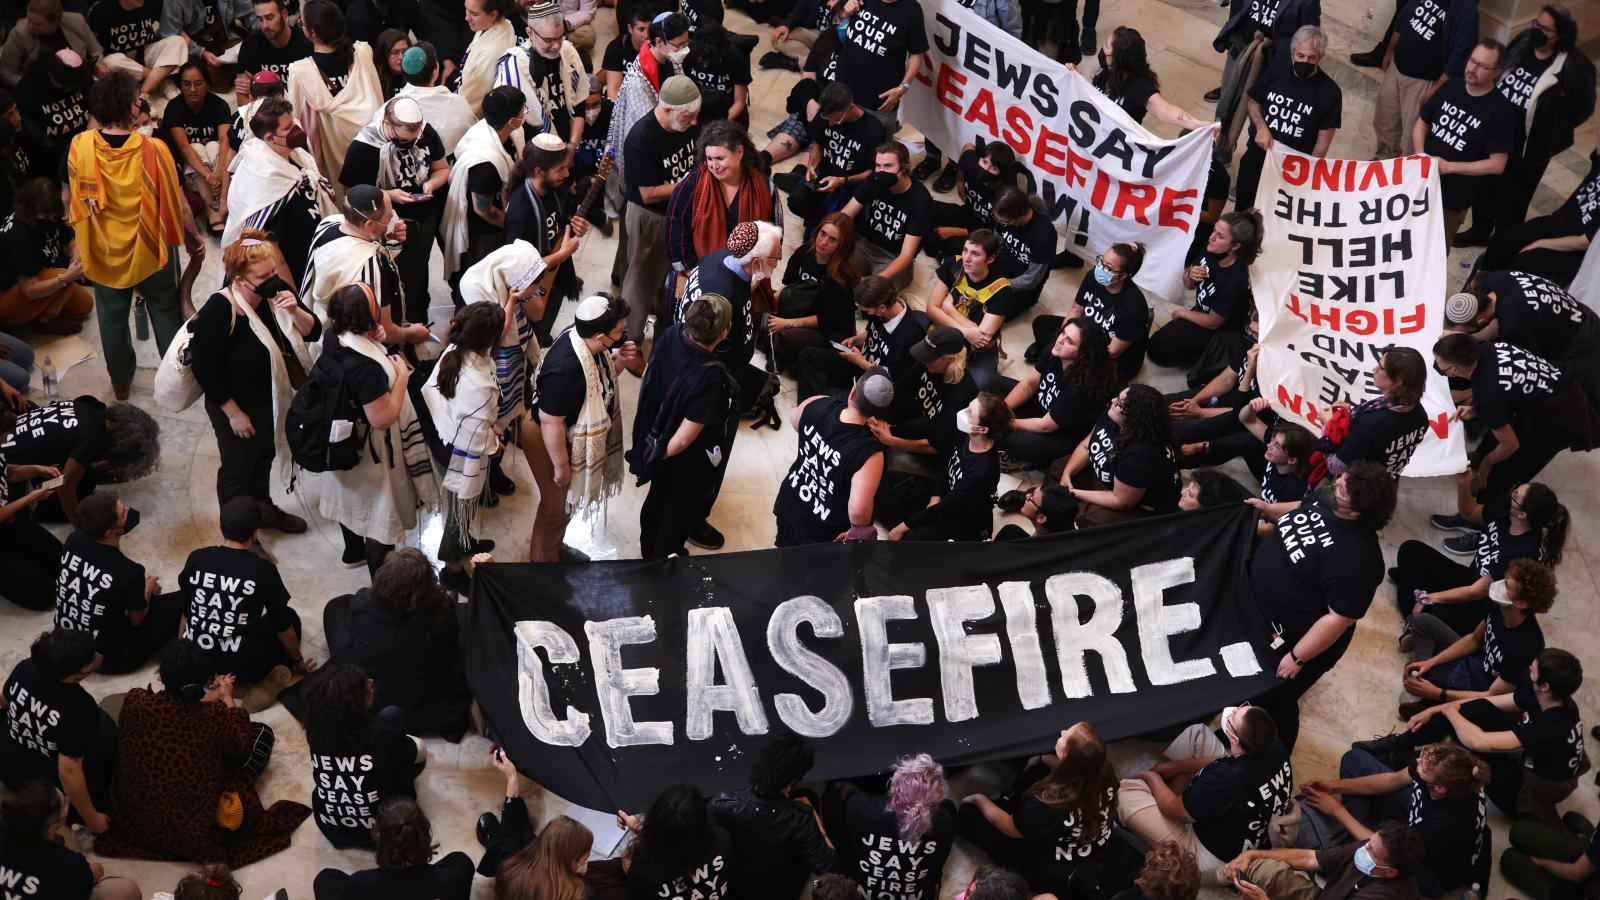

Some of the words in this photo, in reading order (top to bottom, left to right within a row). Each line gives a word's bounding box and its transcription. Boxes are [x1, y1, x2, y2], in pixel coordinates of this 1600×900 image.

[1424, 0, 1440, 13] OT
[110, 24, 136, 35] NOT
[141, 18, 152, 28] IN
[854, 20, 885, 43] OUR
[858, 10, 880, 24] NOT
[882, 22, 897, 35] IN
[118, 31, 148, 44] OUR
[847, 27, 887, 56] NAME
[261, 64, 288, 73] NOT
[1516, 67, 1531, 80] OT
[934, 12, 1059, 117] JEWS
[1068, 100, 1176, 178] SAY
[1505, 74, 1534, 96] OUR
[42, 99, 66, 114] NOT
[71, 92, 84, 104] IN
[52, 104, 84, 124] OUR
[1267, 92, 1294, 108] NOT
[1297, 102, 1313, 116] IN
[1268, 104, 1302, 125] OUR
[1442, 100, 1466, 119] NOT
[1466, 115, 1482, 130] IN
[184, 126, 198, 136] OT
[1431, 122, 1467, 152] NAME
[1440, 114, 1467, 136] OUR
[824, 128, 845, 144] NOT
[848, 139, 862, 151] IN
[830, 140, 850, 159] OUR
[662, 148, 684, 168] NOT
[672, 155, 694, 178] OUR
[1281, 154, 1431, 192] LIVING
[872, 198, 894, 213] NOT
[897, 210, 908, 224] IN
[1274, 188, 1347, 228] THE
[1359, 187, 1429, 225] FOR
[874, 210, 901, 230] OUR
[1287, 229, 1412, 267] HELL
[1297, 270, 1405, 302] LIKE
[1510, 270, 1540, 310] JEWS
[1084, 306, 1110, 330] OUR
[1285, 293, 1425, 335] FIGHT
[1494, 342, 1512, 392] JEWS
[1512, 345, 1526, 384] SAY
[59, 400, 80, 430] EWS
[918, 387, 936, 419] OUR
[804, 425, 840, 467] JEWS
[1097, 428, 1114, 452] NOT
[1386, 426, 1425, 454] JEWS
[1278, 512, 1306, 564] NAME
[1293, 513, 1316, 548] OUR
[1309, 504, 1325, 529] OT
[1318, 531, 1334, 548] IN
[1488, 522, 1499, 546] NOT
[61, 550, 113, 589] JEWS
[60, 568, 100, 600] SAY
[189, 570, 256, 596] JEWS
[56, 579, 106, 616] EASE
[195, 588, 242, 611] SAY
[190, 600, 248, 625] CEASE
[182, 623, 242, 652] NOW
[190, 614, 236, 638] FIRE
[514, 556, 1263, 748] CEASEFIRE.
[1492, 646, 1503, 663] IN
[10, 682, 60, 727] JEWS
[10, 700, 48, 736] SAY
[312, 754, 374, 772] JEWS
[320, 772, 365, 792] SAY
[1248, 762, 1291, 807] EWS
[318, 786, 380, 805] CEASE
[325, 804, 372, 817] FIRE
[862, 834, 937, 855] JEWS
[860, 860, 929, 881] CEASE
[869, 850, 924, 870] SAY
[658, 855, 724, 898] JEWS
[868, 876, 916, 893] FIRE
